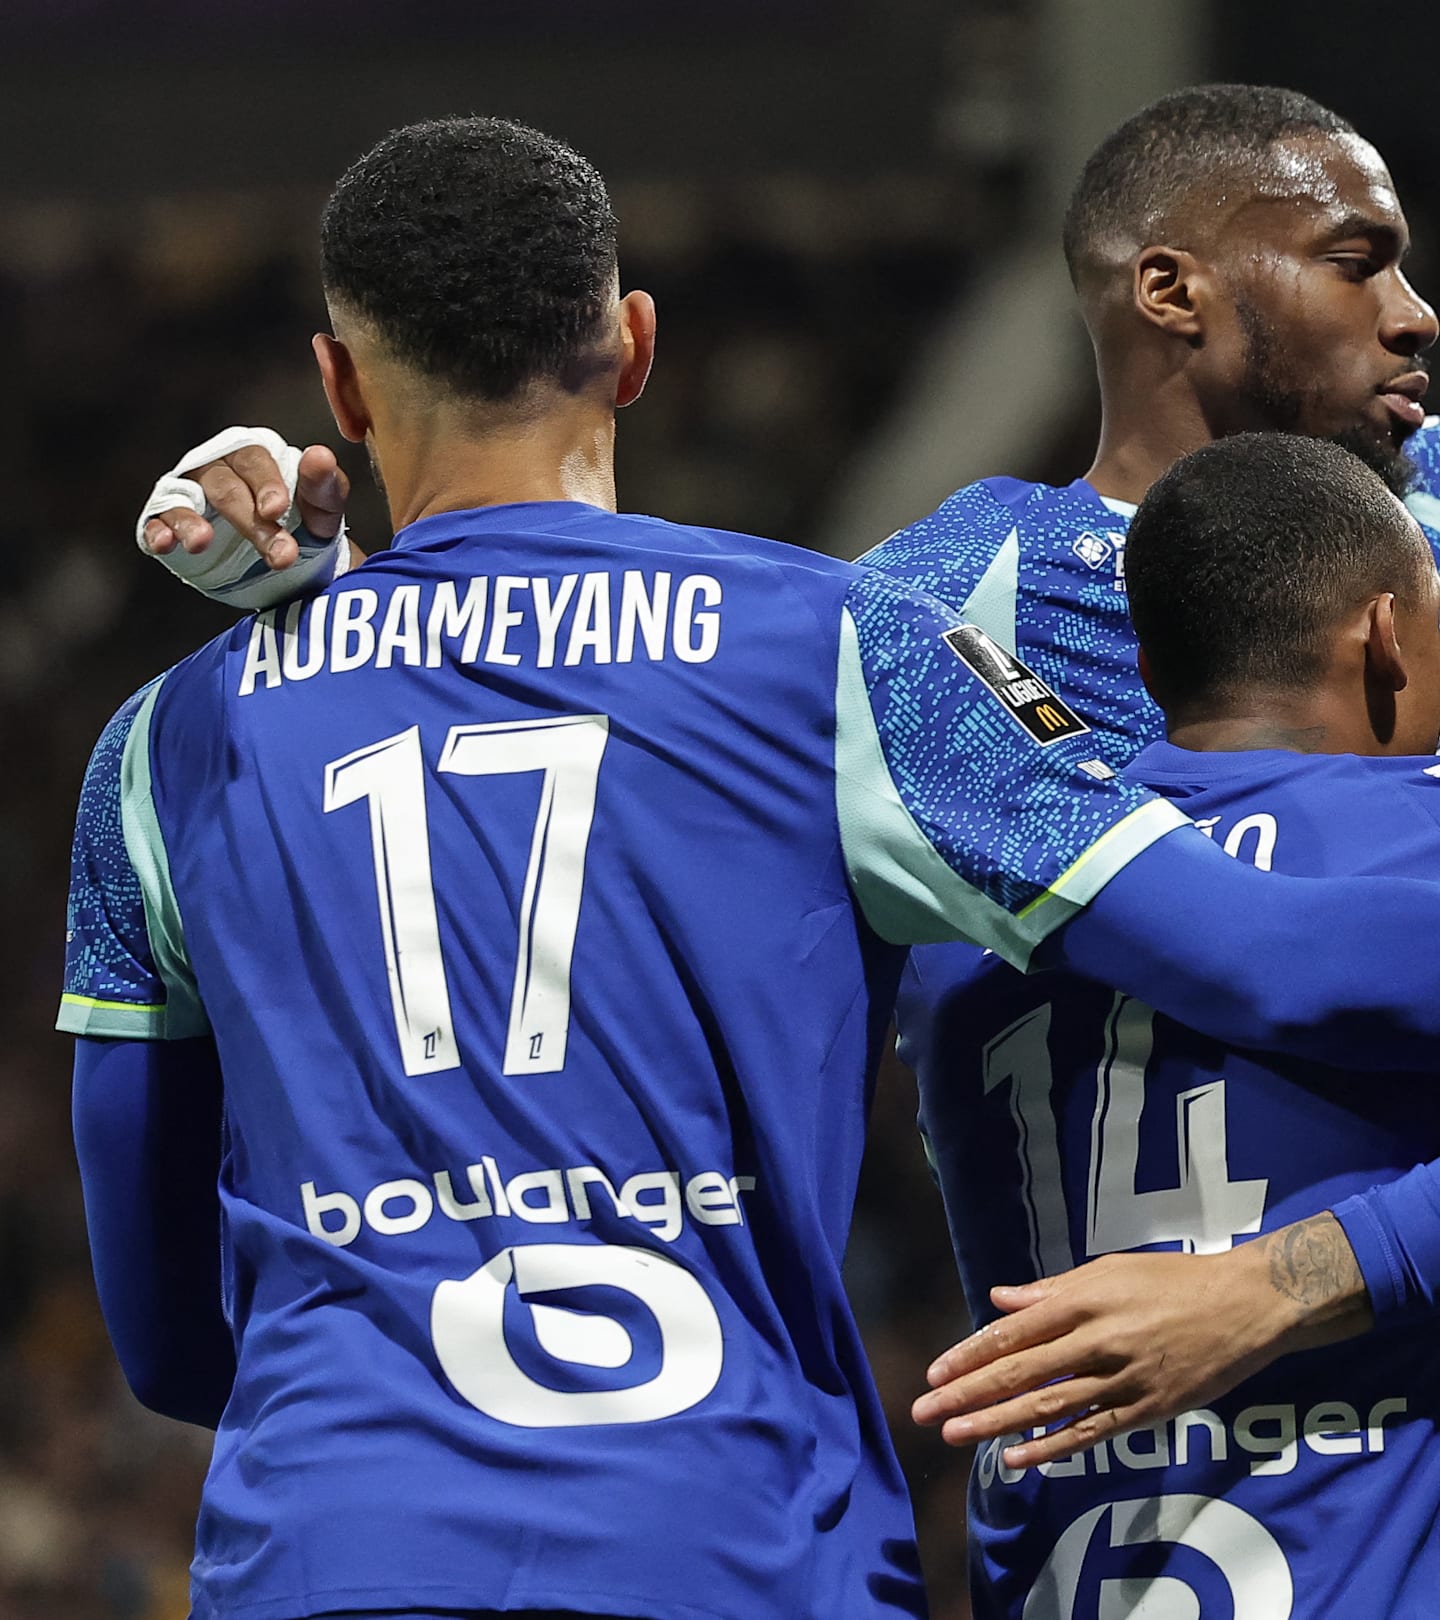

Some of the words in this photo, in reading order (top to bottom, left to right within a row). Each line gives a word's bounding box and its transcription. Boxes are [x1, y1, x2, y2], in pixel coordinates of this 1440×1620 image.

[238, 570, 722, 697] AUBAMEYANG
[323, 714, 610, 1077] 17
[301, 1155, 756, 1248] boulanger
[982, 990, 1269, 1280] 14
